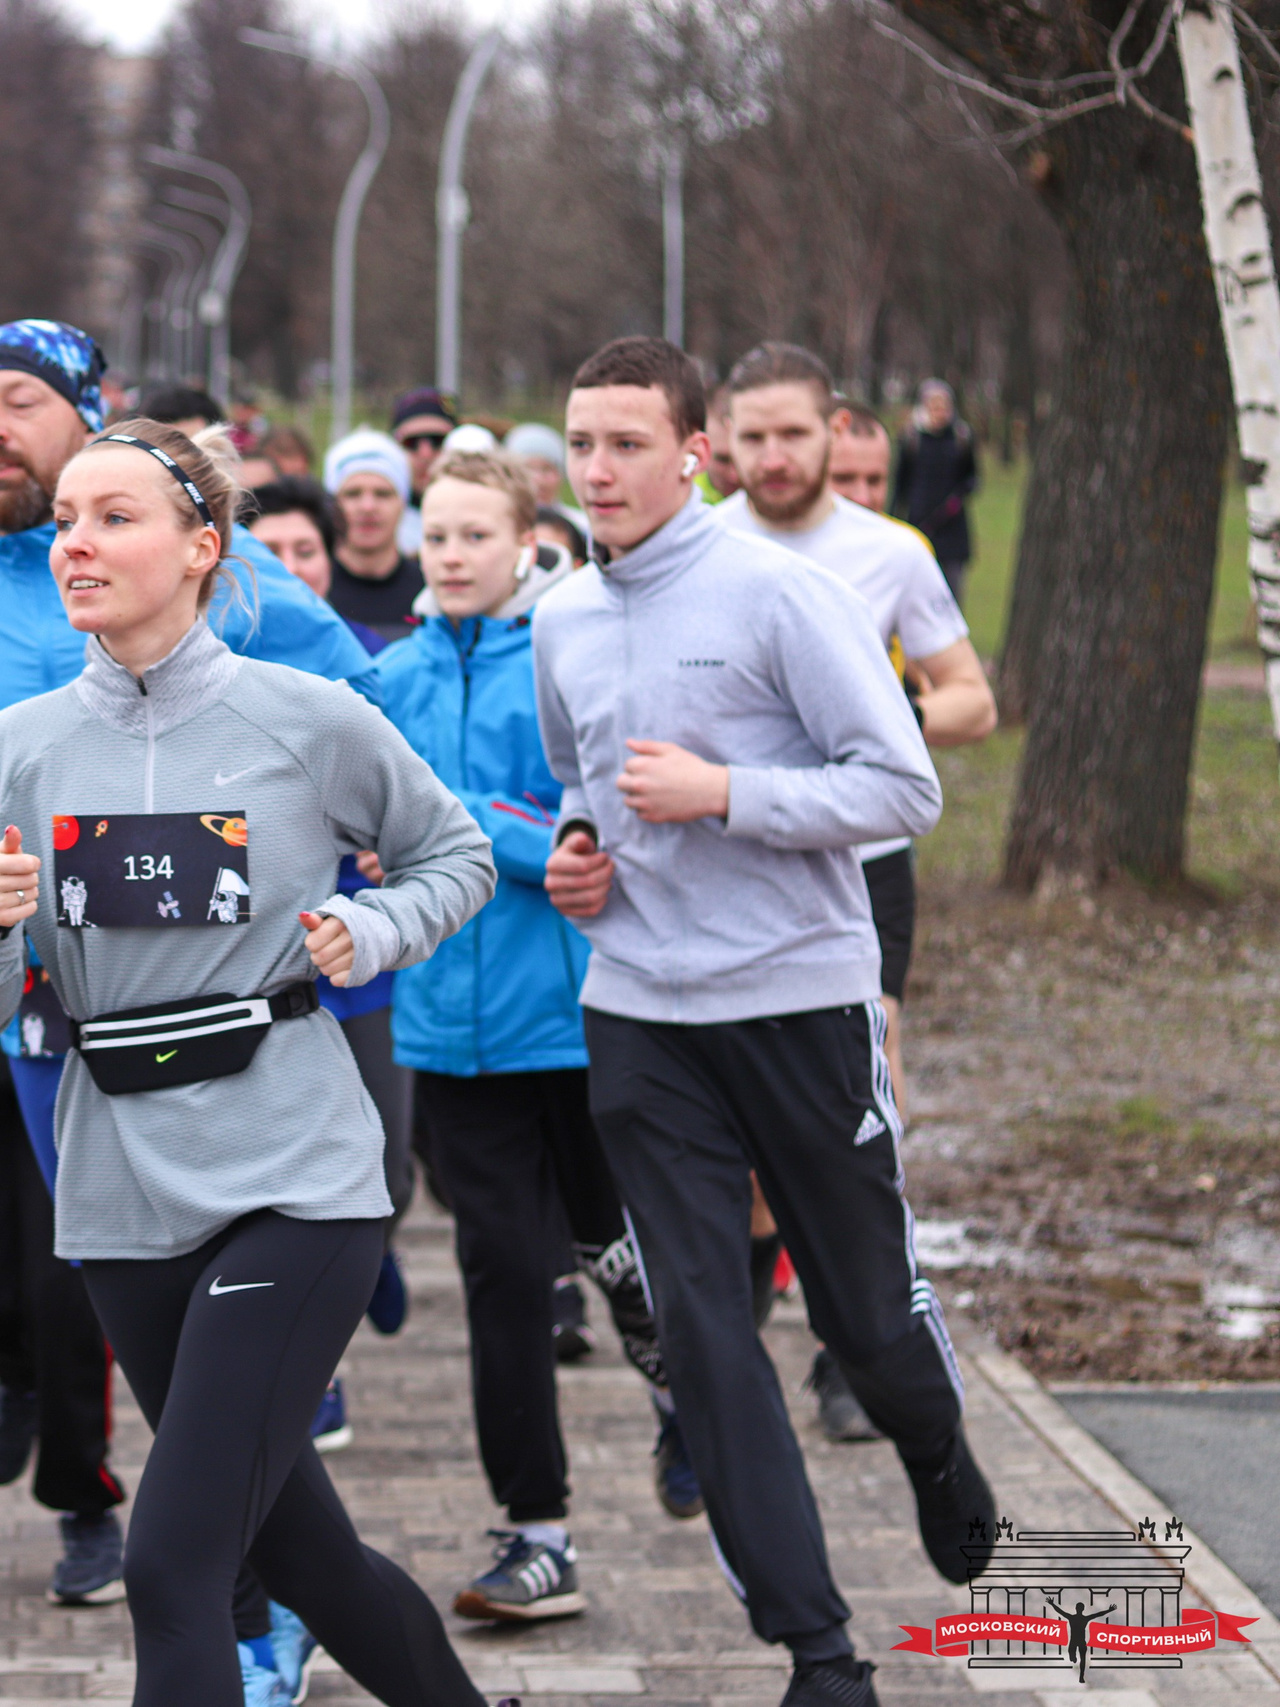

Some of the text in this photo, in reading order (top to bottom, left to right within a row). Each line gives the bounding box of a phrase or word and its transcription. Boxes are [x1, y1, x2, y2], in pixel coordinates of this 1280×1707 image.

[149, 448, 177, 468] NIKE
[184, 482, 206, 505] NIKE
[123, 854, 175, 880] 134
